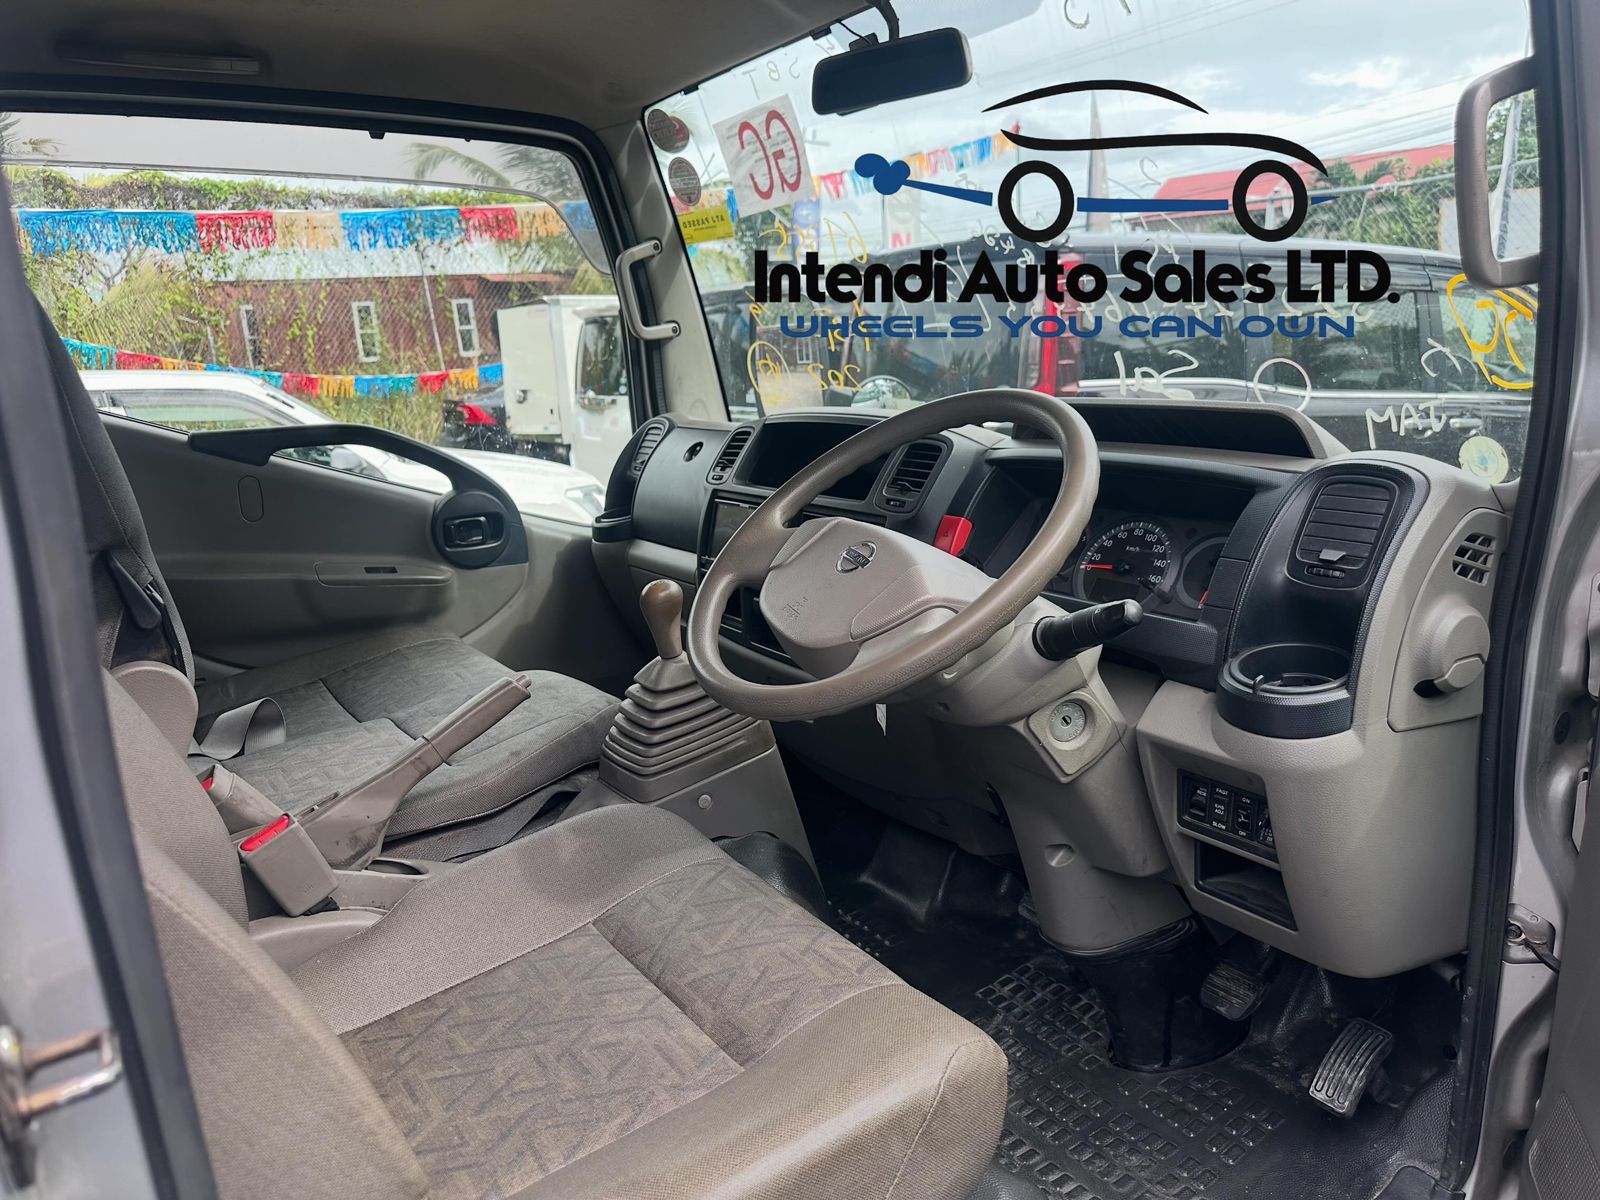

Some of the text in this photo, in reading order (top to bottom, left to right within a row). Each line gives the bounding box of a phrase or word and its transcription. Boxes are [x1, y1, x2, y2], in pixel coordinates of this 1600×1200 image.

[1117, 531, 1128, 539] 60
[1133, 528, 1144, 536] 80
[1145, 534, 1158, 542] 100
[1103, 539, 1113, 547] 40
[1152, 544, 1165, 553] 120
[1091, 553, 1101, 561] 20
[1153, 559, 1167, 568] 140
[1149, 574, 1162, 583] 160
